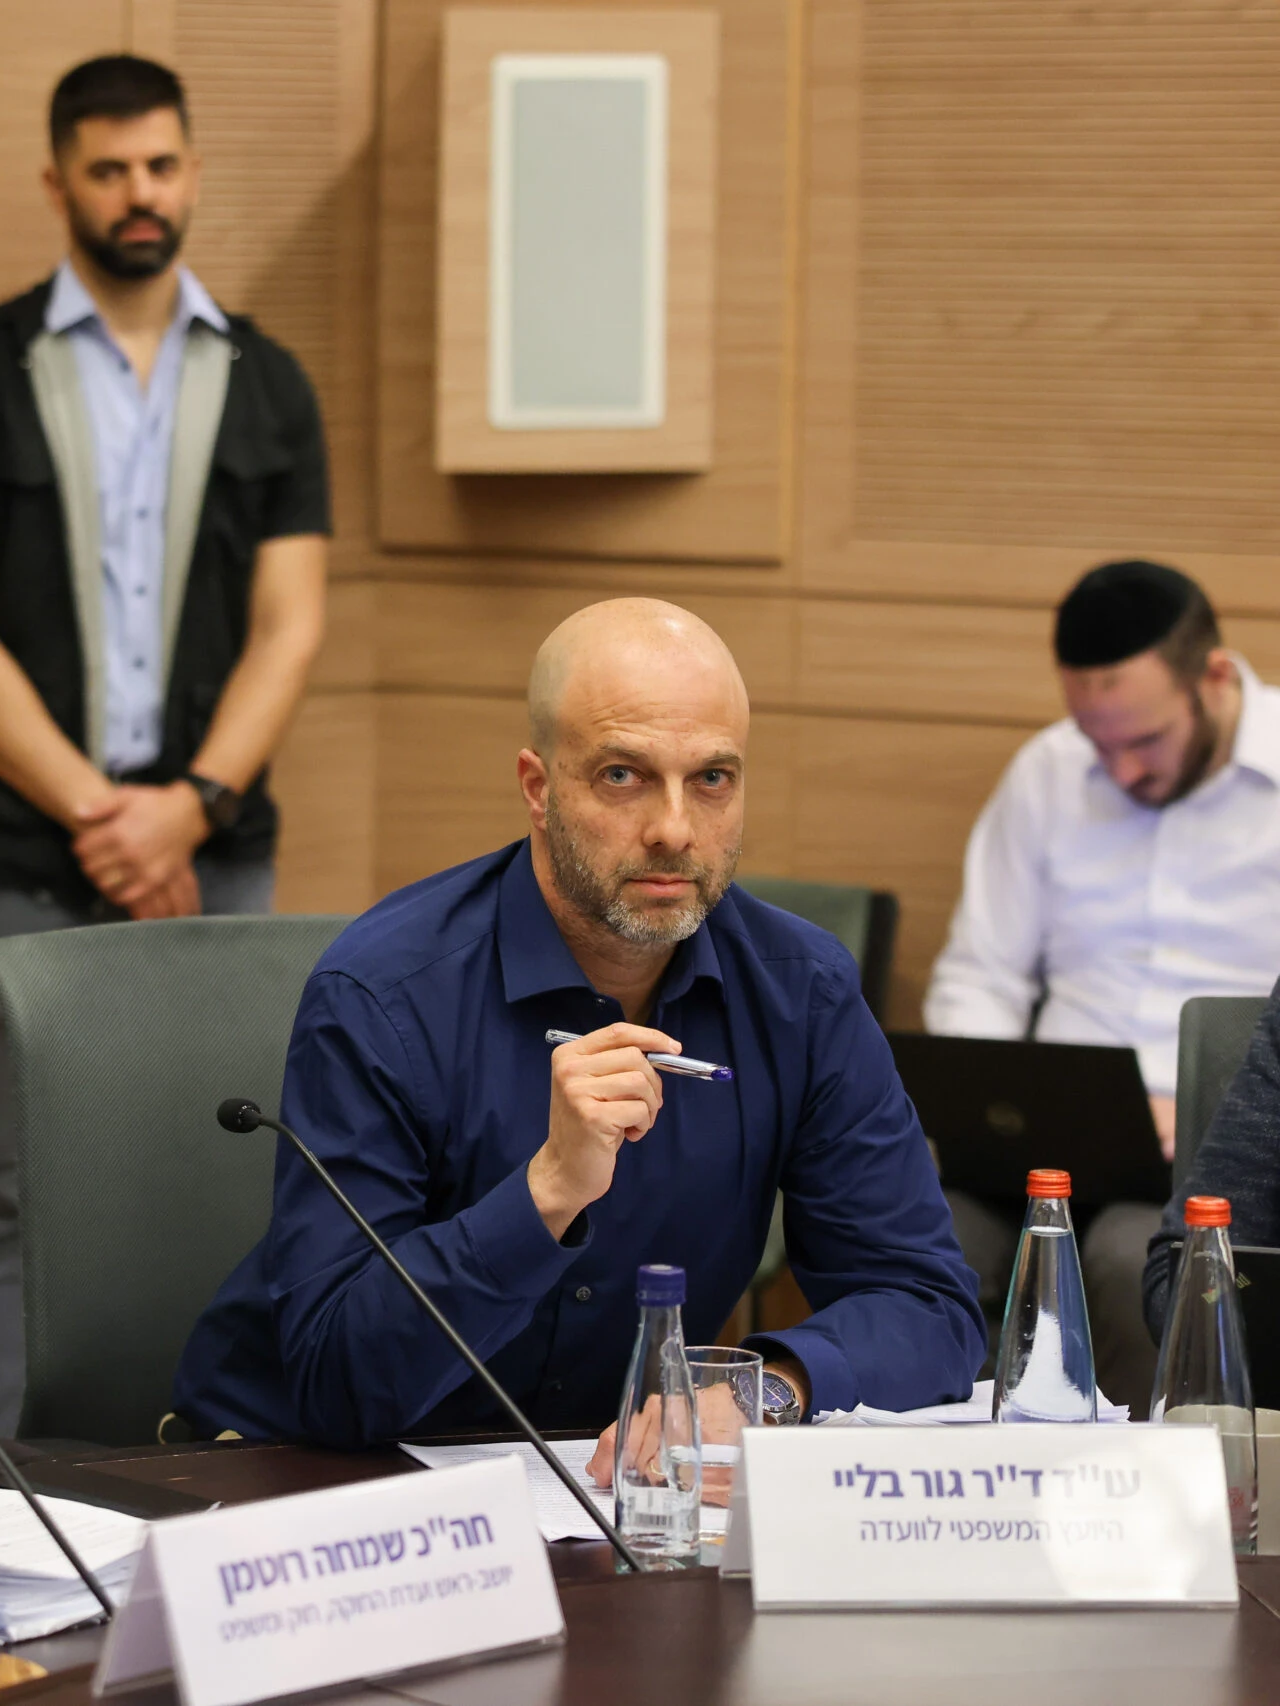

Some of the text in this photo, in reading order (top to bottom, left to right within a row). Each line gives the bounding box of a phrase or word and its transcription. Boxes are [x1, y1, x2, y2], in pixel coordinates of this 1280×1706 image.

[833, 1463, 905, 1499] בליי
[911, 1469, 966, 1499] גור
[972, 1464, 1044, 1499] ד"ר
[860, 1515, 942, 1543] לוועדה
[949, 1518, 1051, 1542] המשפטי
[218, 1513, 494, 1607] חה"כ שמחה רוטמן
